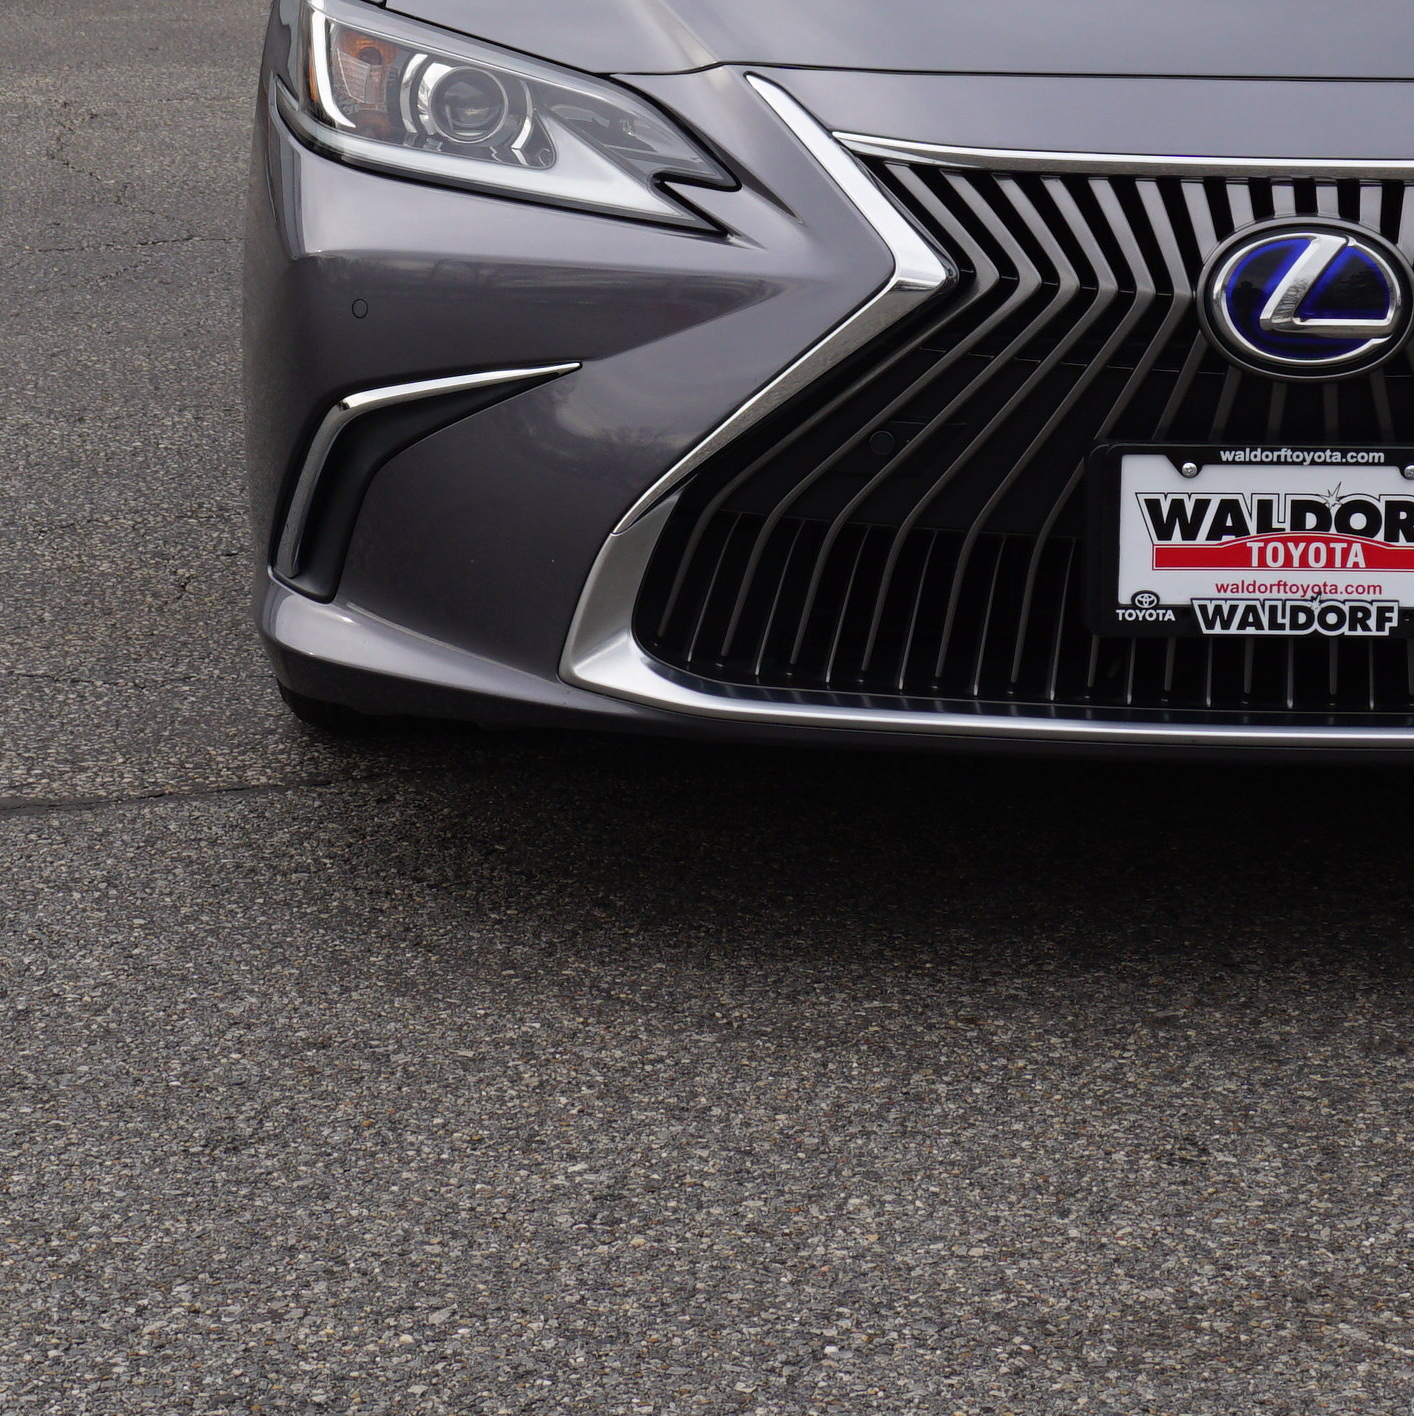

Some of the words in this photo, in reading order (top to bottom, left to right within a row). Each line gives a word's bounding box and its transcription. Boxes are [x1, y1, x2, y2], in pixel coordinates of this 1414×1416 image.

[1219, 448, 1385, 465] waldorftoyota.com
[1246, 542, 1366, 569] TOYOTA
[1215, 580, 1383, 597] waldorftoyota.com
[1116, 609, 1175, 623] TOYOTA
[1196, 603, 1397, 633] WALDORF
